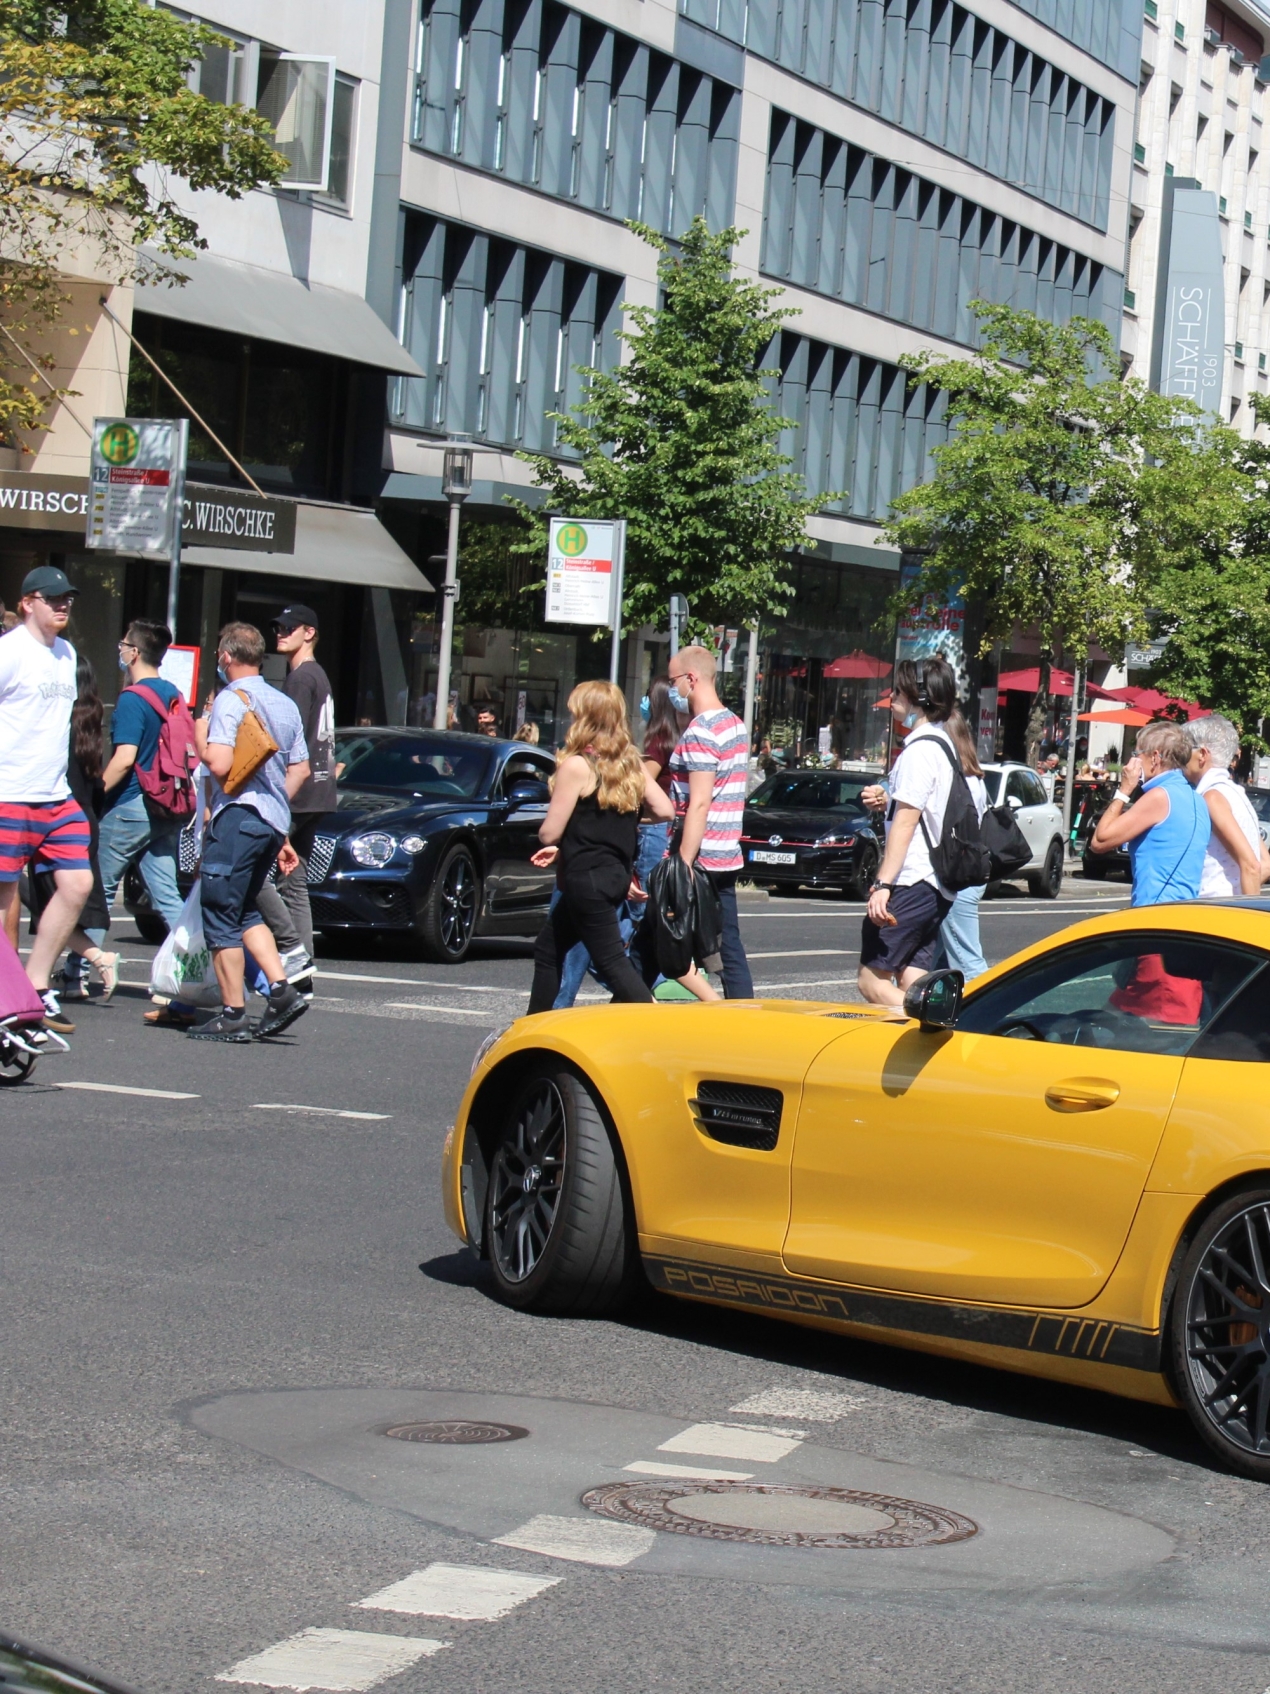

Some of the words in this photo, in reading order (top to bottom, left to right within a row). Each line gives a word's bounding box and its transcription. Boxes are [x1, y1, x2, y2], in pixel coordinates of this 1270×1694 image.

[1202, 353, 1218, 387] 1903
[95, 468, 109, 482] 12
[552, 558, 564, 569] 12
[766, 853, 776, 861] MS
[777, 854, 792, 862] 605
